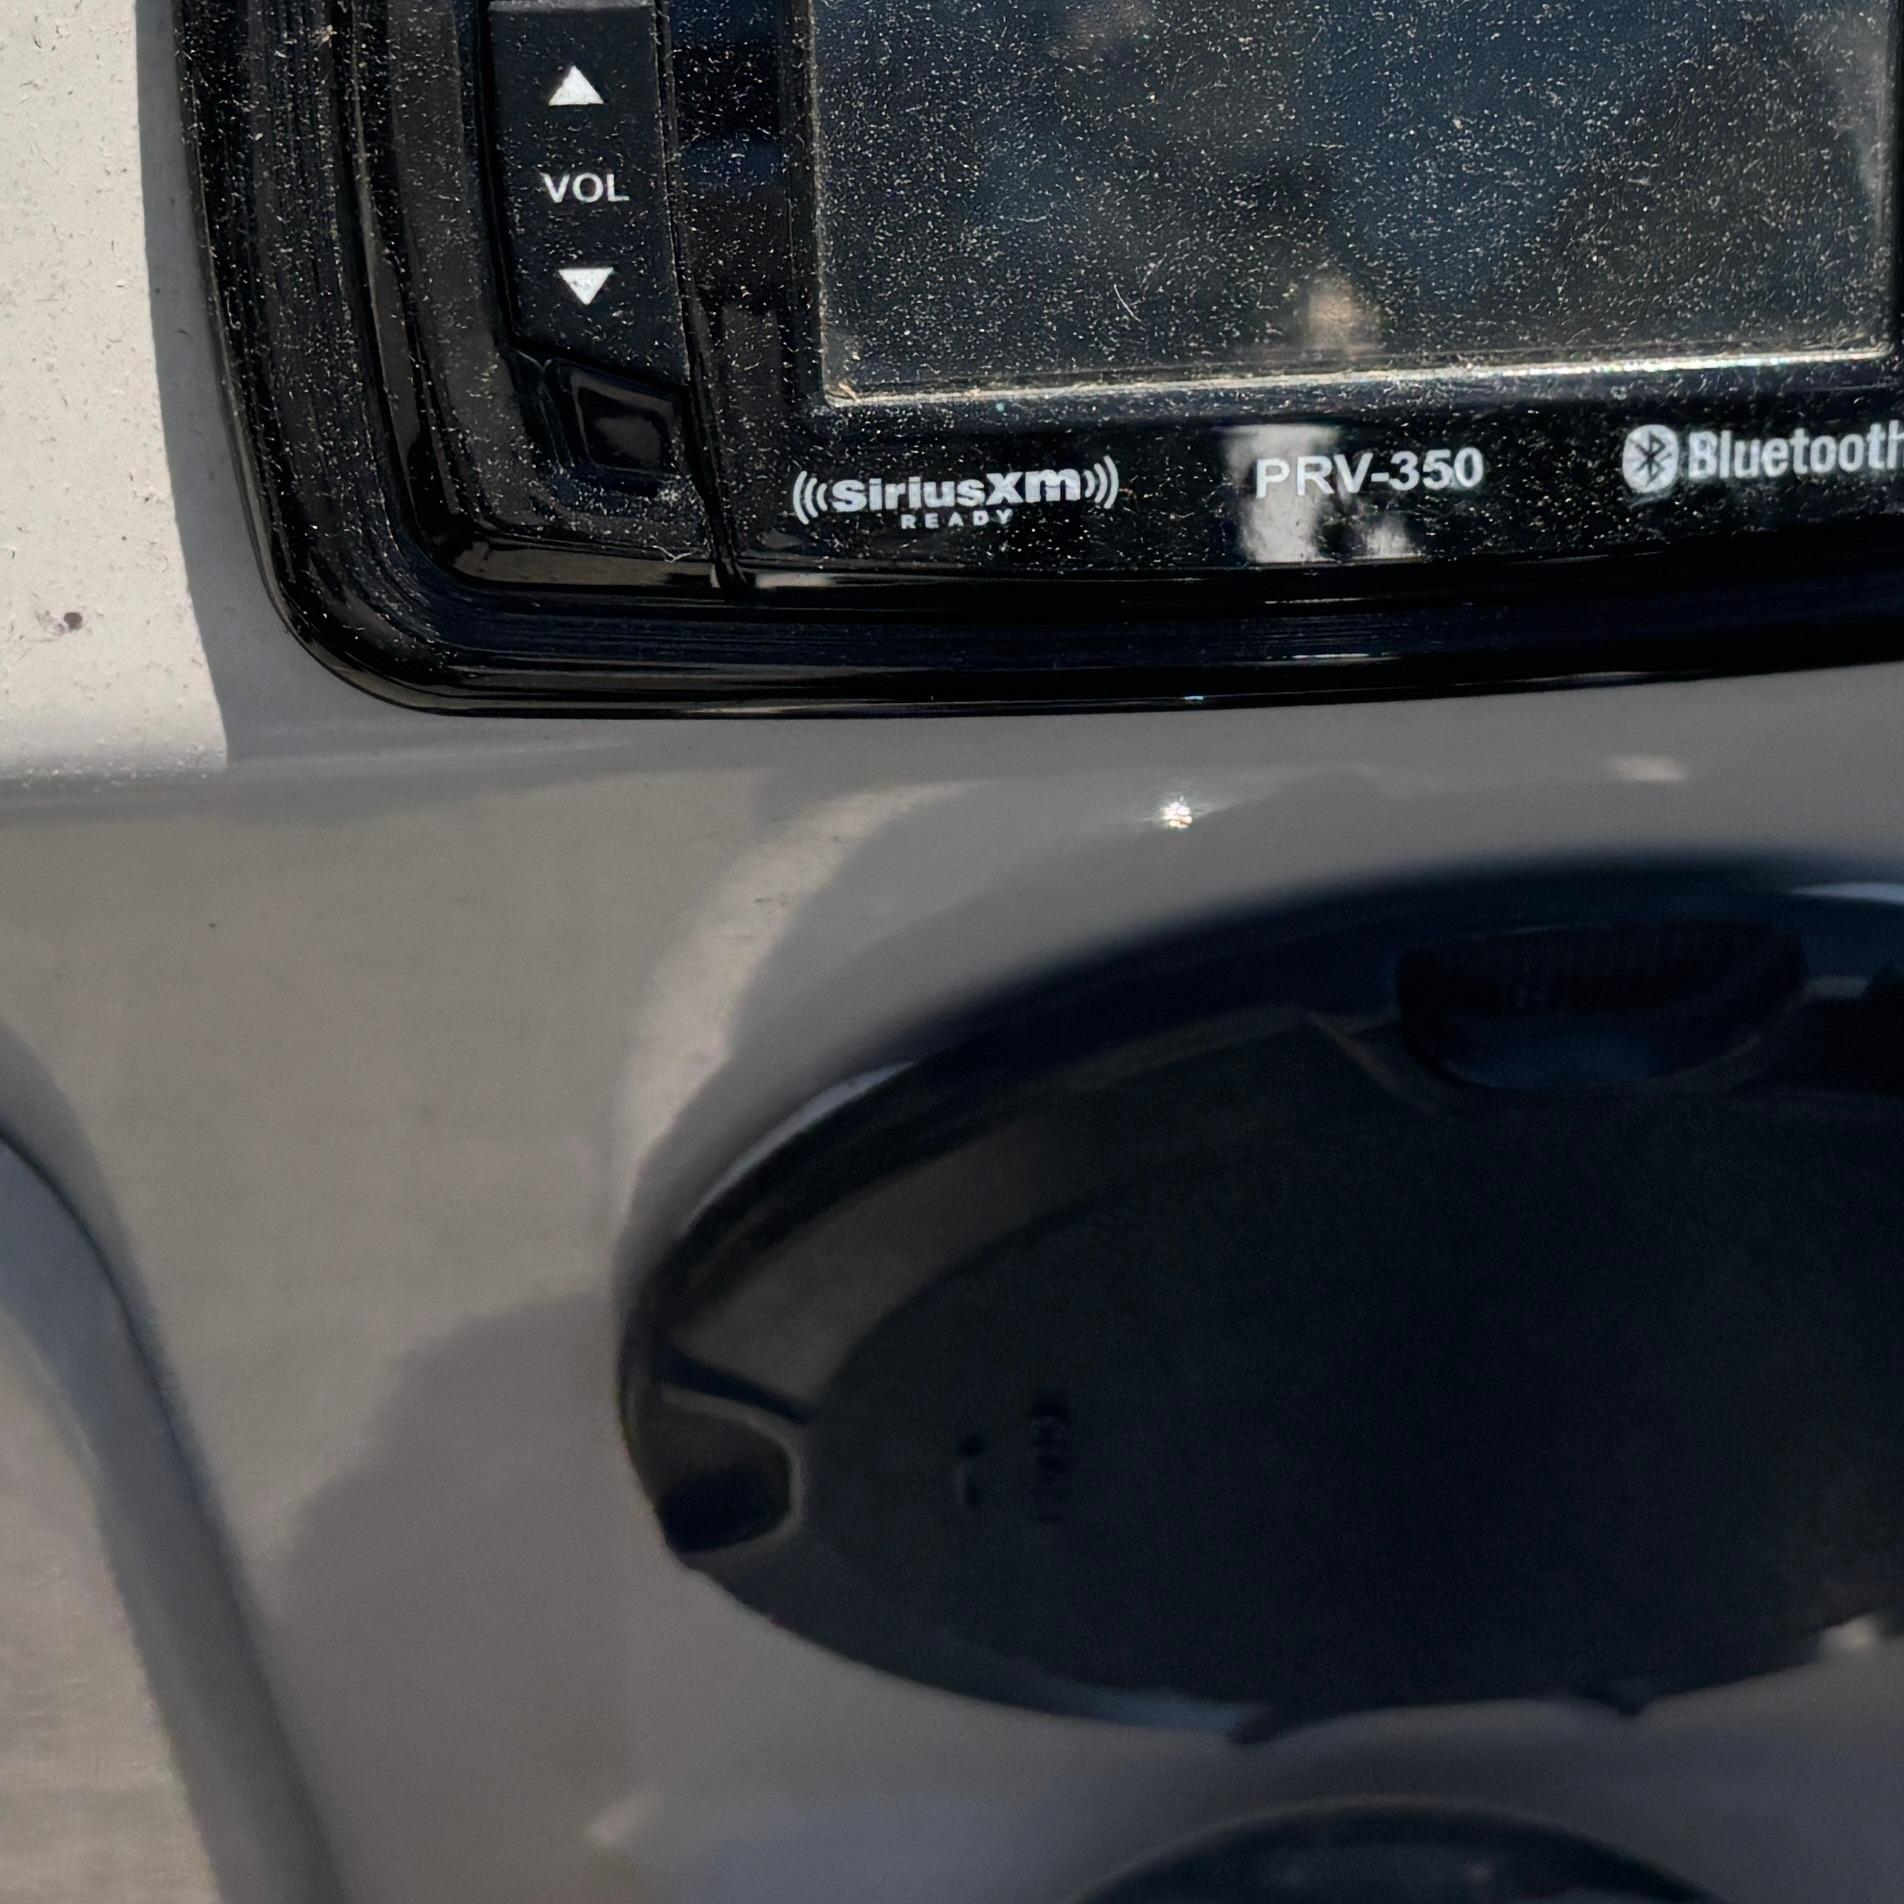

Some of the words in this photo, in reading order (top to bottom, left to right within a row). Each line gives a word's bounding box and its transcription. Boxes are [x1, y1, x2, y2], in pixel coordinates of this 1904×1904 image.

[542, 172, 630, 204] VOL
[1254, 446, 1486, 499] PRV-350
[900, 508, 1014, 530] READY
